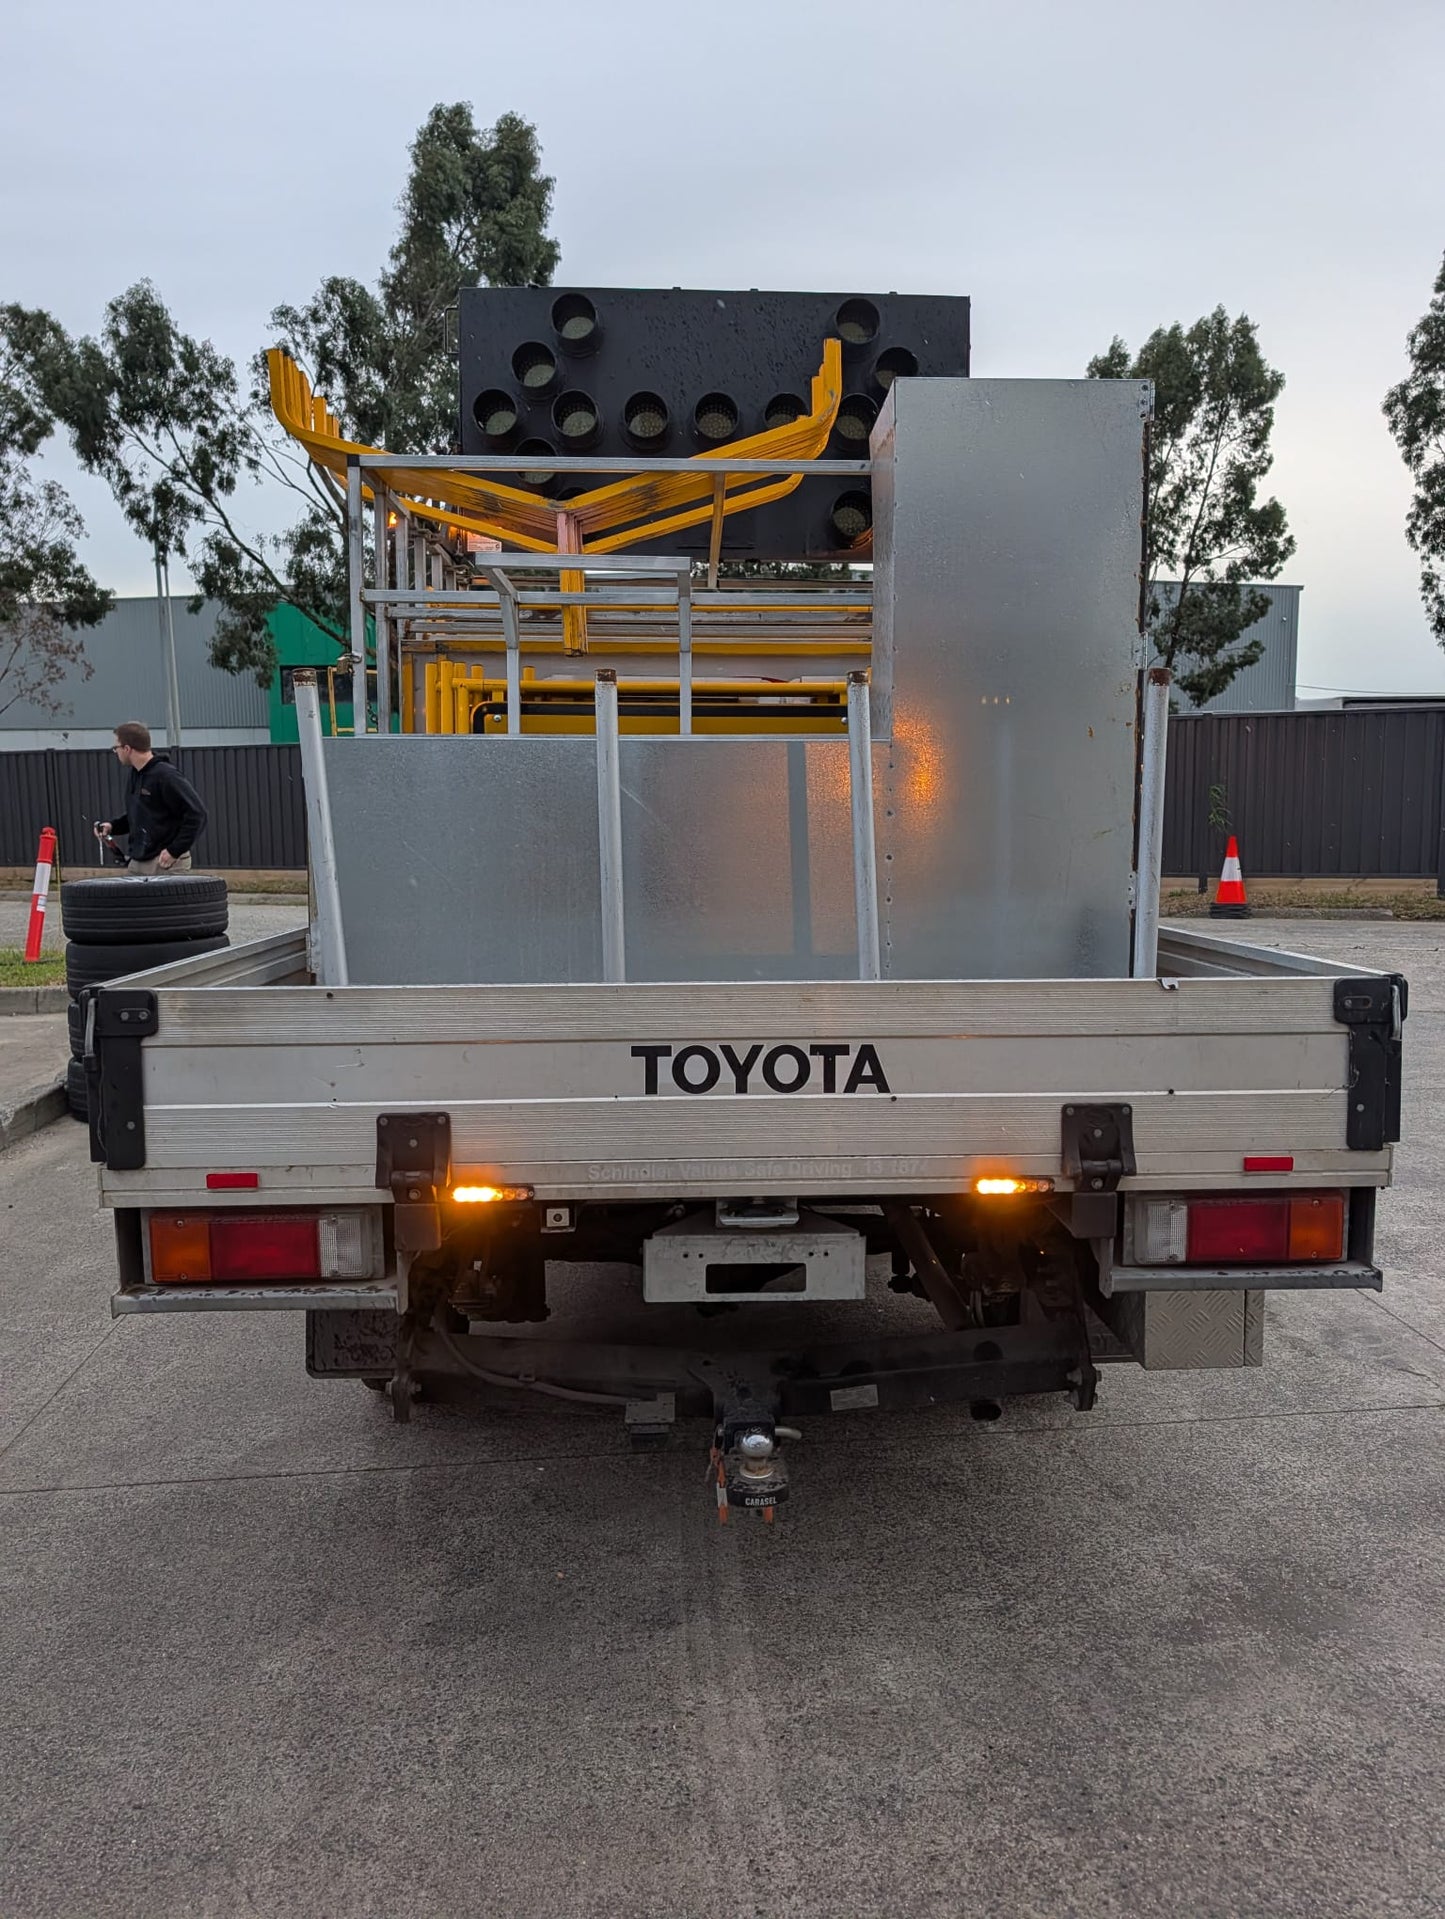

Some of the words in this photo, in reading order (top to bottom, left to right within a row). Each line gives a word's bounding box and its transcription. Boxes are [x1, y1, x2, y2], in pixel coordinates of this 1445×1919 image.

[631, 1044, 891, 1095] TOYOTA
[745, 1161, 783, 1177] Safe
[789, 1160, 851, 1177] Driving
[745, 1496, 777, 1506] CARASEL
